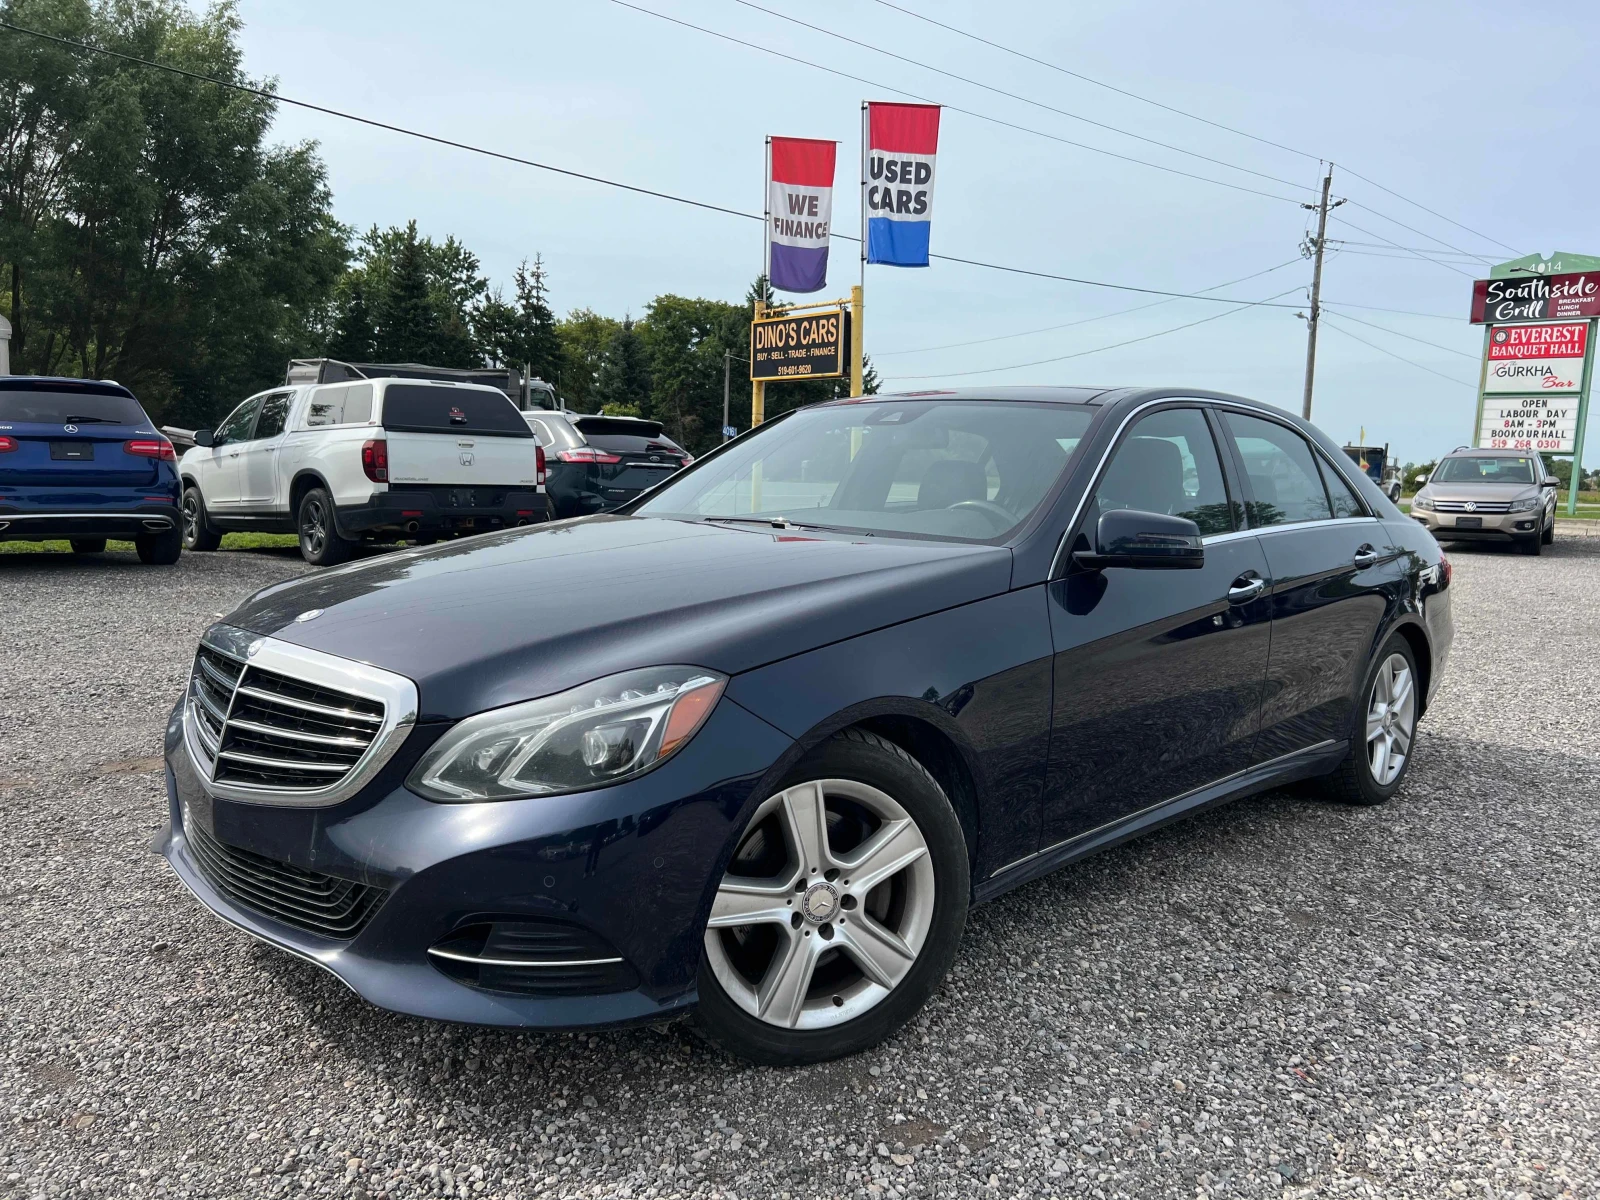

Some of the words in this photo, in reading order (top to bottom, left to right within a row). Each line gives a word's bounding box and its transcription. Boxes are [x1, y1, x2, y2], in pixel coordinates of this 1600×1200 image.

[869, 156, 932, 185] USED
[787, 193, 819, 217] WE
[868, 185, 928, 215] CARS
[774, 217, 827, 239] FINANCE
[1528, 261, 1562, 273] 4014
[1486, 276, 1599, 304] Southside
[1495, 300, 1544, 320] Grill
[756, 322, 797, 349] DINO'S
[800, 317, 837, 345] CARS
[1509, 326, 1584, 344] EVEREST
[756, 352, 768, 361] BUY
[788, 349, 807, 358] TRADE
[811, 347, 835, 356] FINANCE
[1491, 344, 1548, 358] BANQUET
[1549, 343, 1582, 355] HALL
[1496, 366, 1554, 377] GURKHA
[1541, 375, 1575, 388] Bar
[1521, 399, 1548, 408] OPEN
[1500, 410, 1539, 418] LABOUR
[1546, 410, 1567, 418] DAY
[1503, 420, 1524, 428] 8AM
[1536, 419, 1557, 428] 3PM
[1491, 430, 1516, 438] BOOK
[1541, 430, 1567, 438] HALL
[1491, 439, 1507, 448] 519
[1514, 439, 1531, 448] 268
[1537, 439, 1560, 448] 0301
